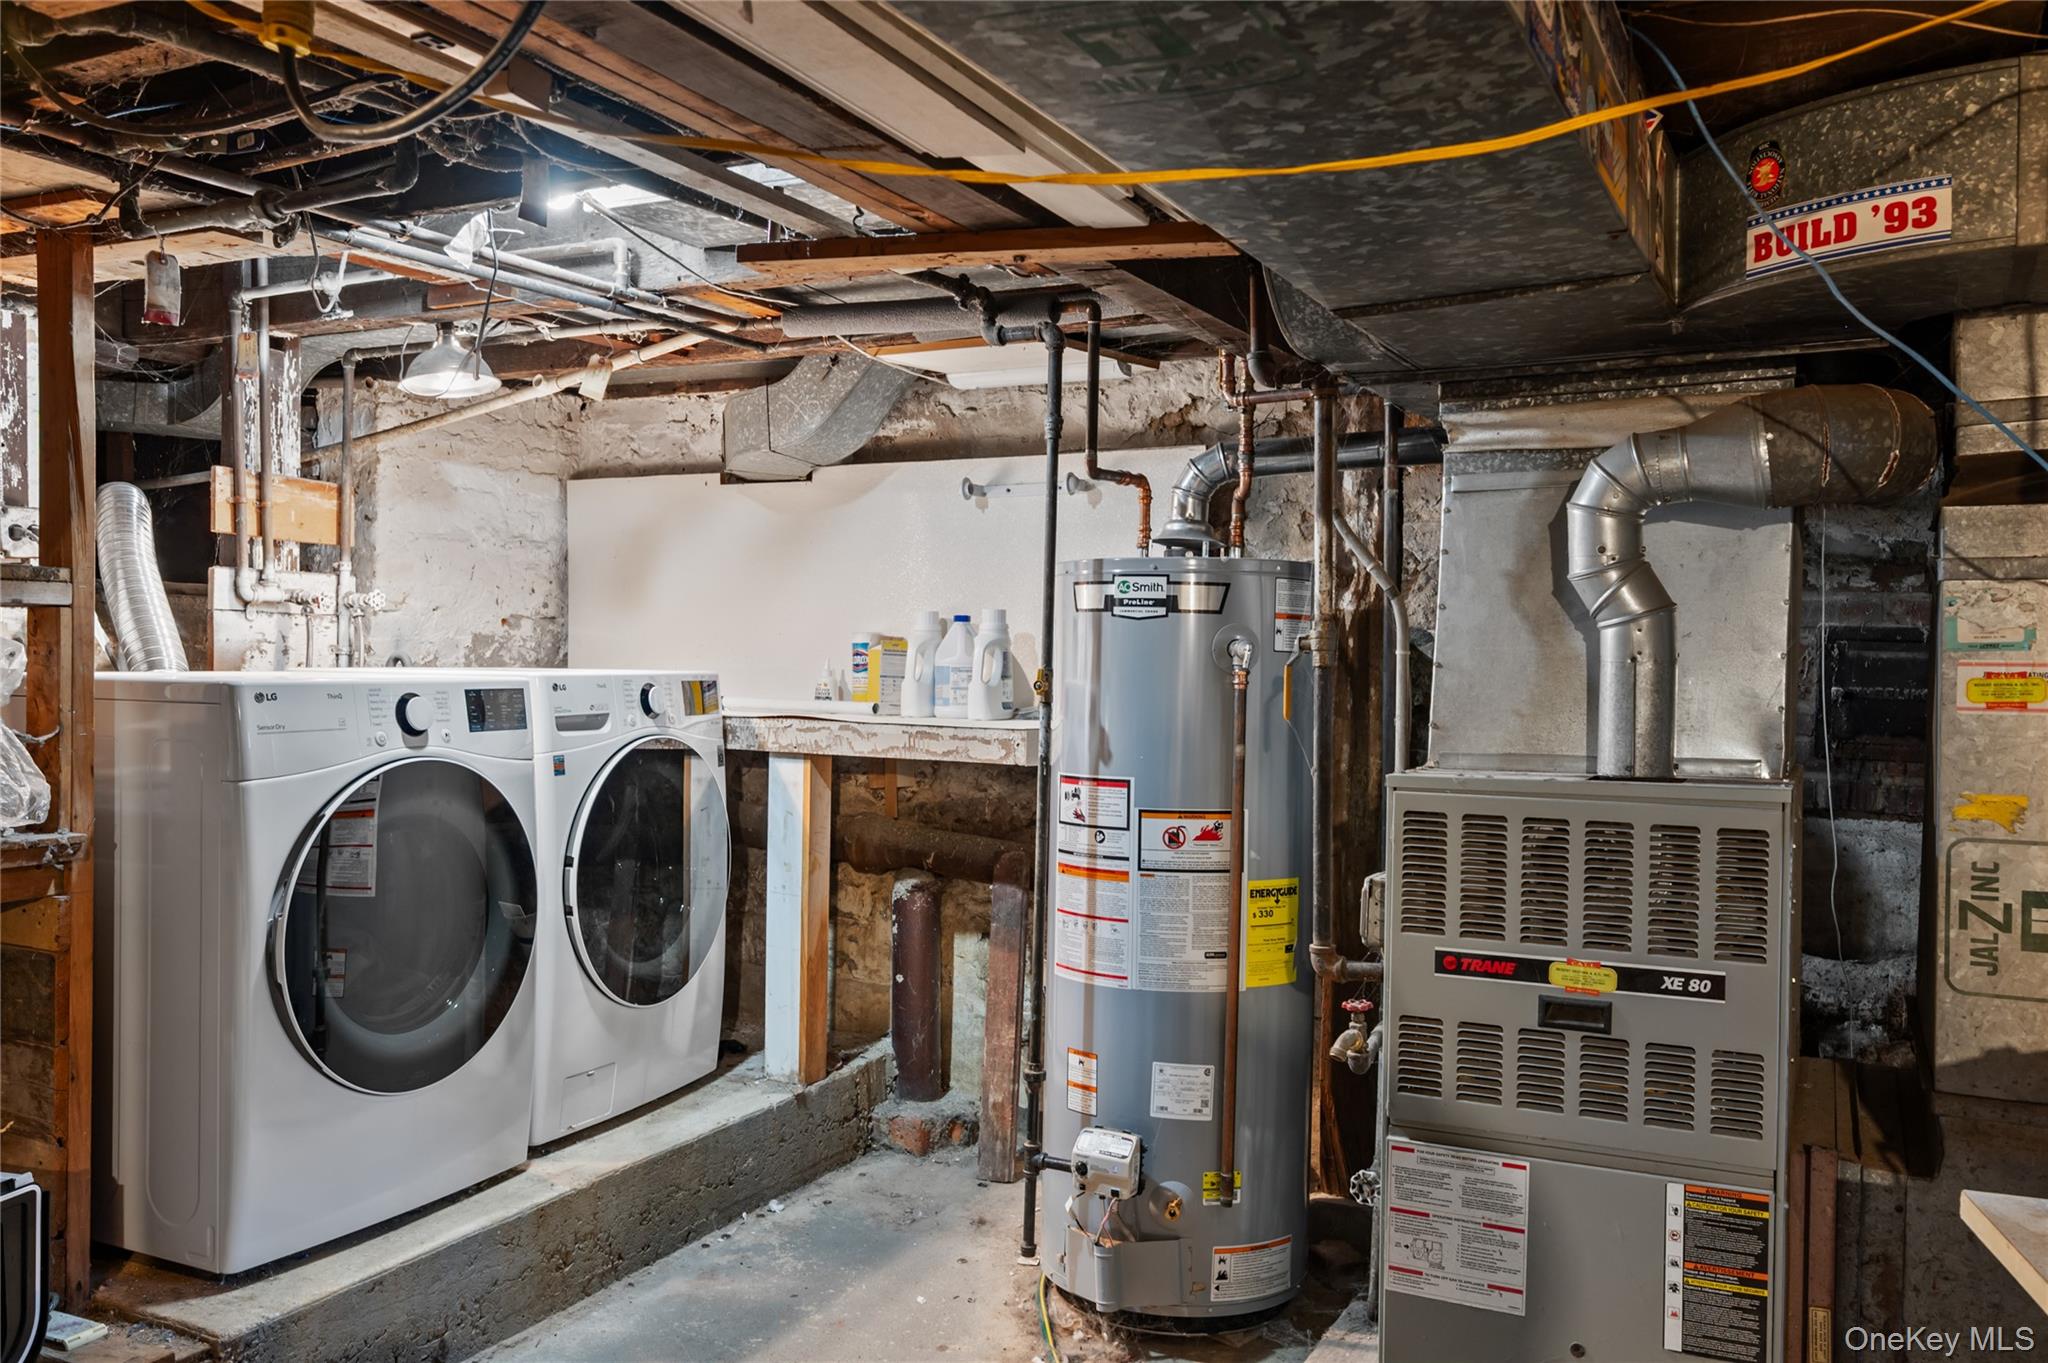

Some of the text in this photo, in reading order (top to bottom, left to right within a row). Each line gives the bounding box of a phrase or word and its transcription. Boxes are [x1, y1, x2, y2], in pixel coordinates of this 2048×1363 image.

[1753, 196, 1937, 263] BUILD '93
[1132, 582, 1164, 592] Smith
[266, 693, 278, 701] LG
[1258, 910, 1274, 918] 330
[1461, 957, 1516, 976] TRANE
[1660, 976, 1711, 993] XE 80
